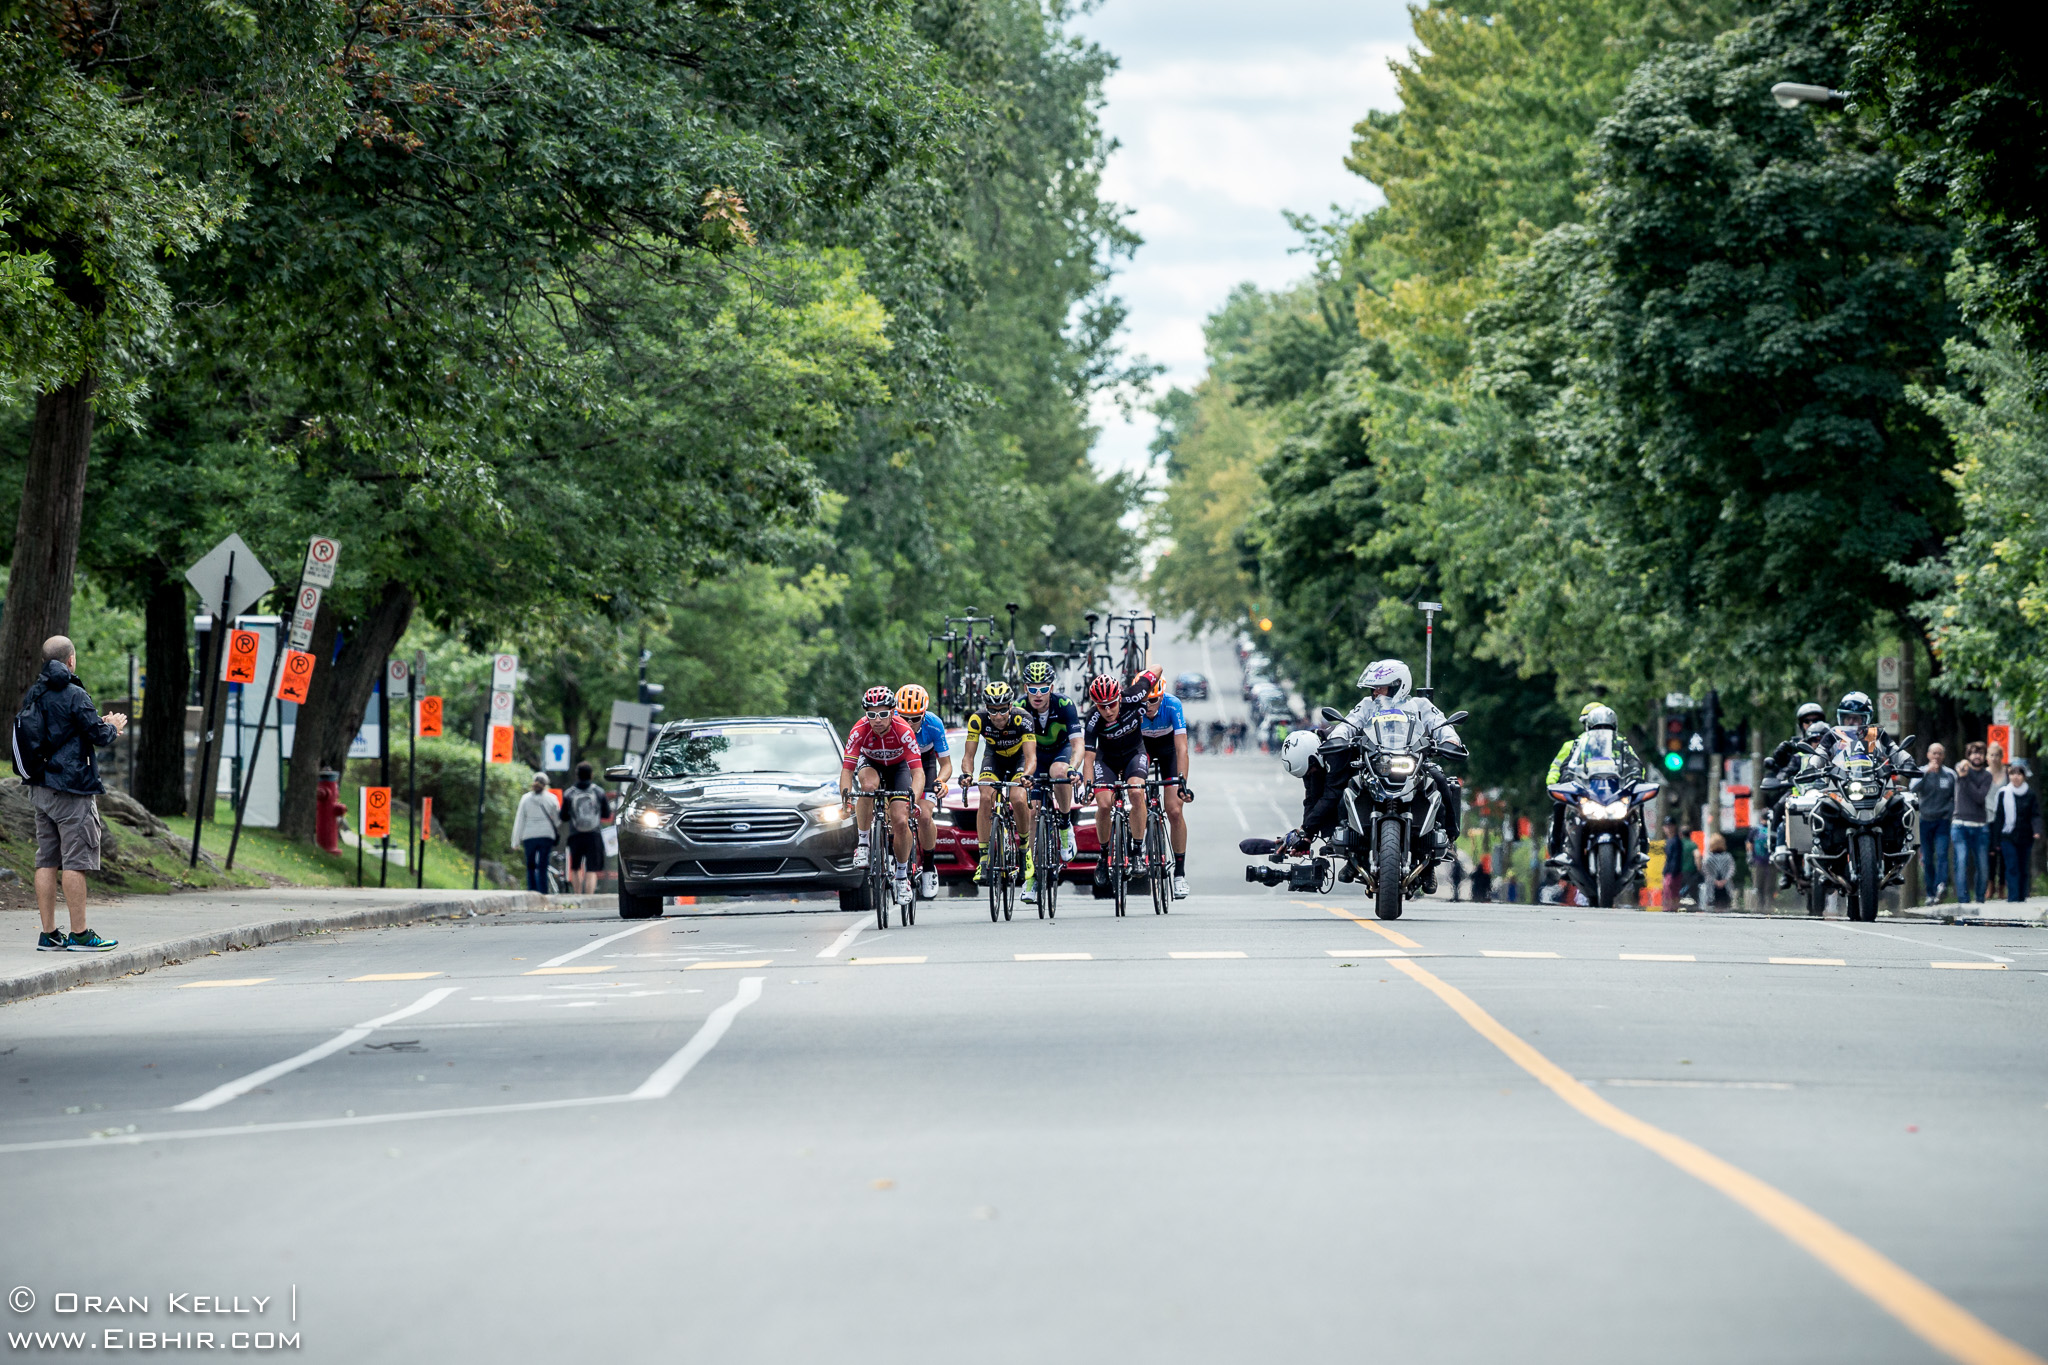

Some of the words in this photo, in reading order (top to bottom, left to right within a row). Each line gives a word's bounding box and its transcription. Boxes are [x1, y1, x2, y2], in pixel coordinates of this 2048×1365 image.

[1125, 689, 1147, 703] BORA
[1088, 711, 1101, 727] BOR
[1853, 741, 1866, 751] A
[961, 837, 979, 845] Géné
